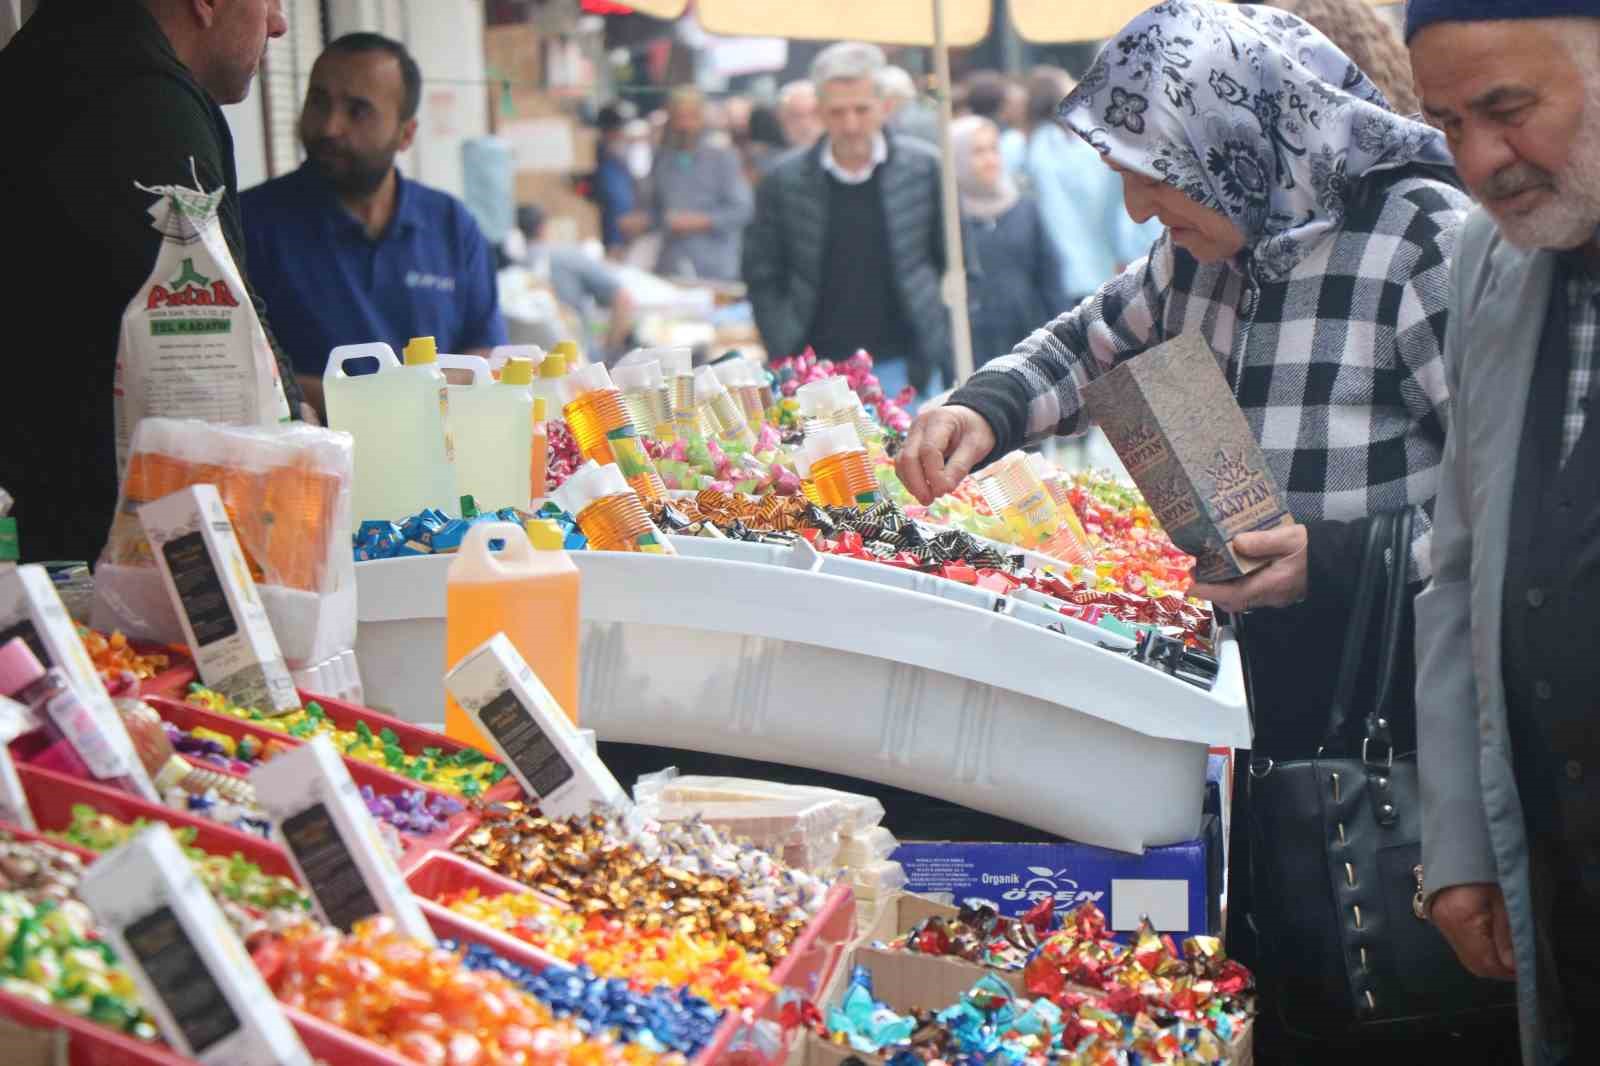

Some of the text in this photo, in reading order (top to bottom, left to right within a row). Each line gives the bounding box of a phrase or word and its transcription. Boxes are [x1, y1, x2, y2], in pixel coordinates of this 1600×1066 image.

[1214, 480, 1269, 521] KAPTAN
[981, 872, 1020, 886] Organik
[1001, 888, 1104, 901] ÖREN
